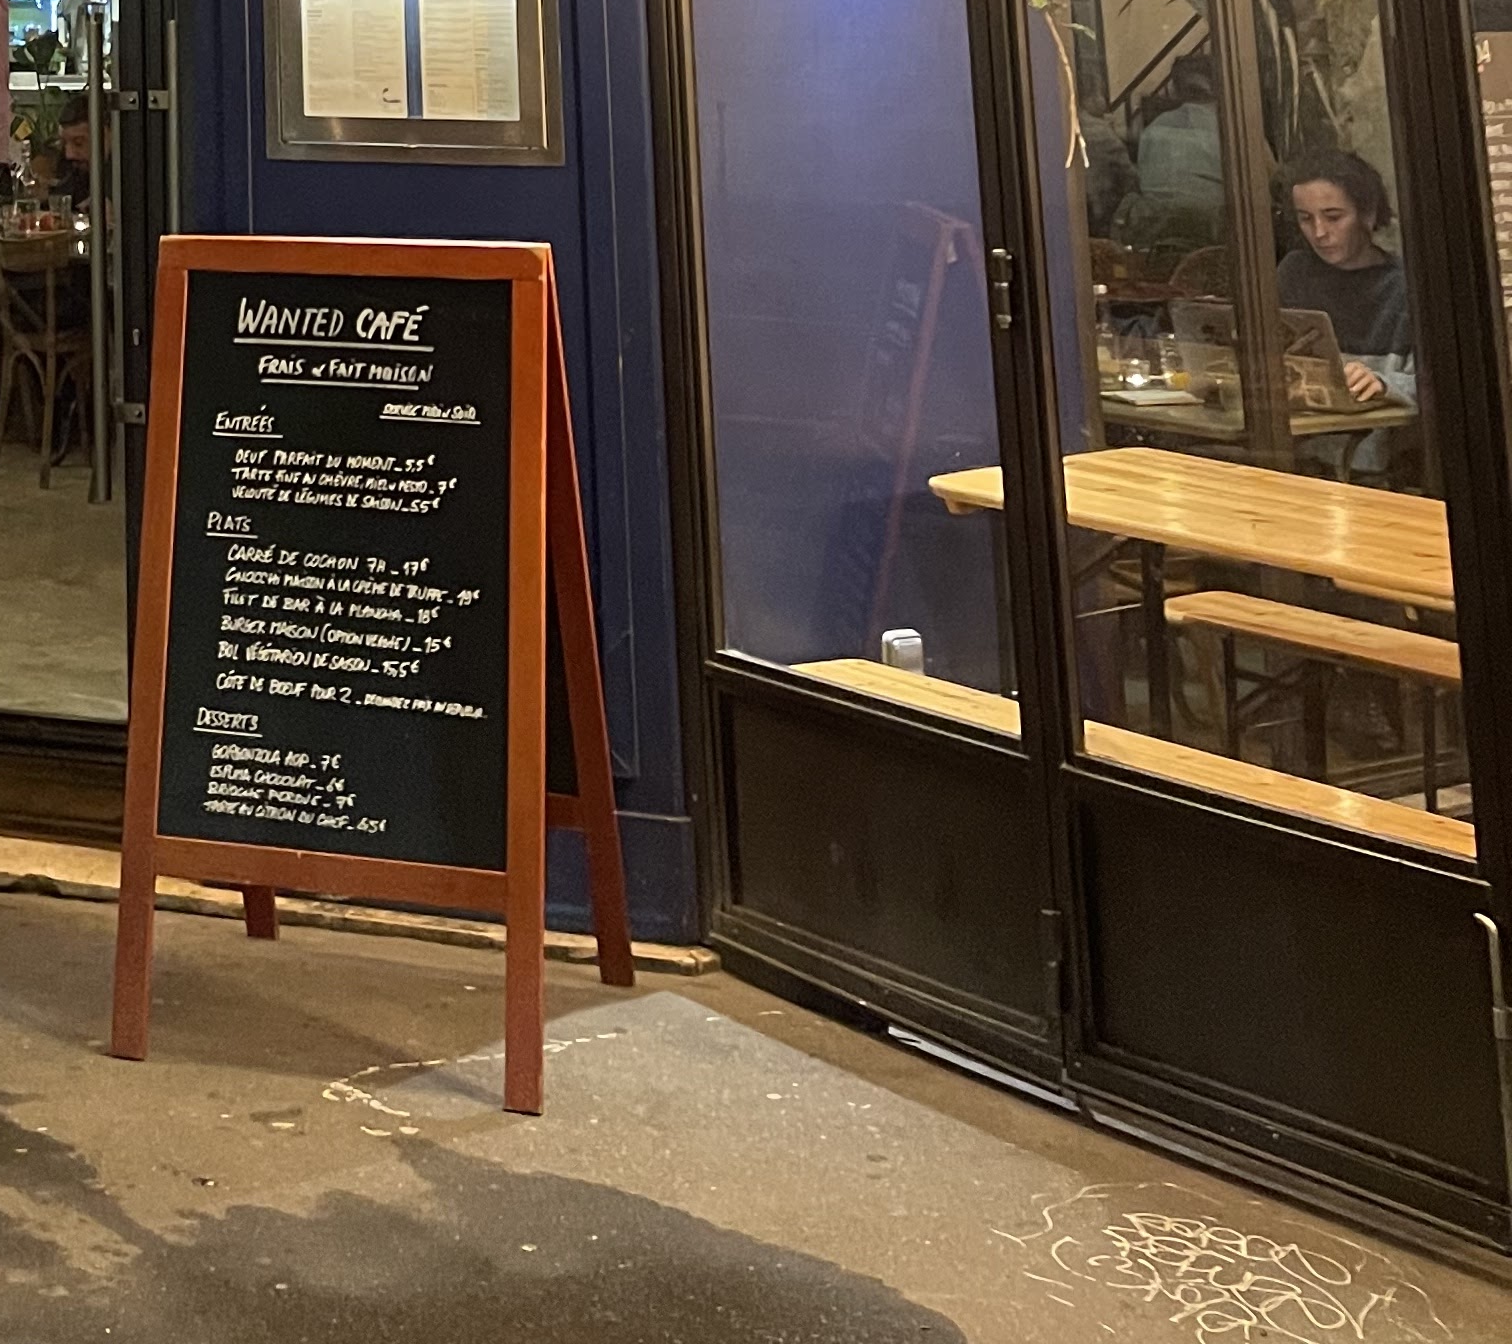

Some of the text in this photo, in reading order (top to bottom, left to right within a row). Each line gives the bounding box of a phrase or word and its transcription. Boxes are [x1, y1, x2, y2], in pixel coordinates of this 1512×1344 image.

[238, 297, 430, 342] WANTED CAFÉ
[207, 511, 252, 532] PLATS
